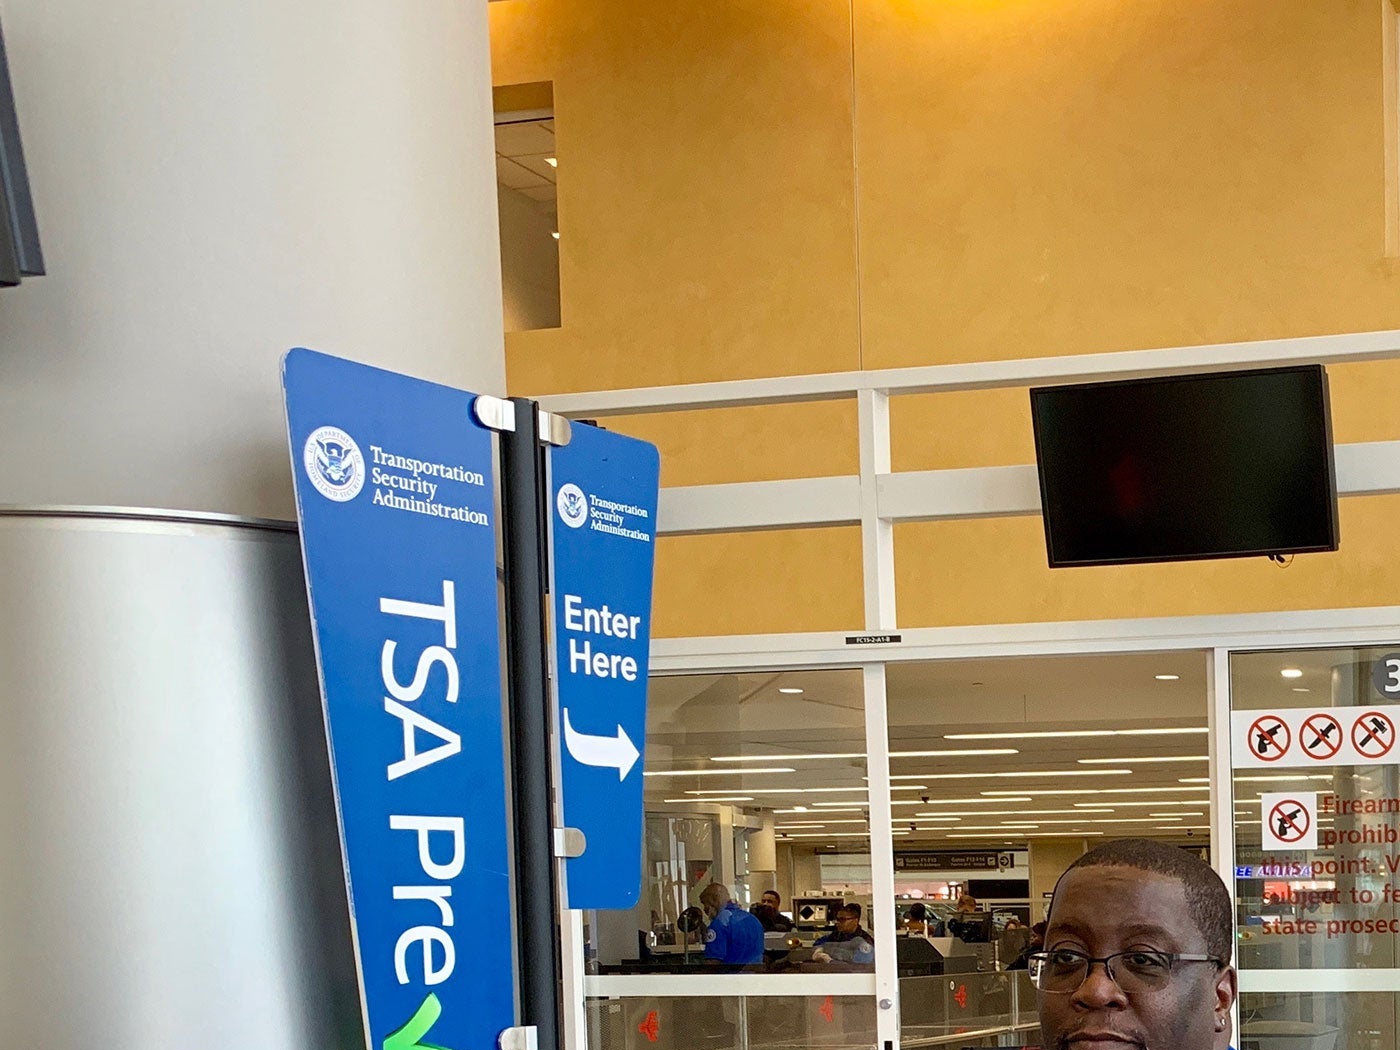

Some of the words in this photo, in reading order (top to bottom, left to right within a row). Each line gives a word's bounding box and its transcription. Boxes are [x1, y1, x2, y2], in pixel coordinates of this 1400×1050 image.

[370, 445, 485, 486] Transportation
[372, 467, 438, 500] Security
[372, 488, 489, 526] Administration
[590, 494, 648, 518] Transportation
[590, 507, 624, 526] Security
[590, 520, 650, 542] Administration
[564, 594, 641, 639] Enter
[569, 638, 638, 681] Here
[379, 580, 462, 781] TSA
[1261, 857, 1301, 877] this
[1311, 856, 1377, 881] point.
[389, 815, 467, 985] Pre
[1262, 886, 1341, 910] subject
[1350, 887, 1373, 903] to
[1262, 918, 1317, 935] state
